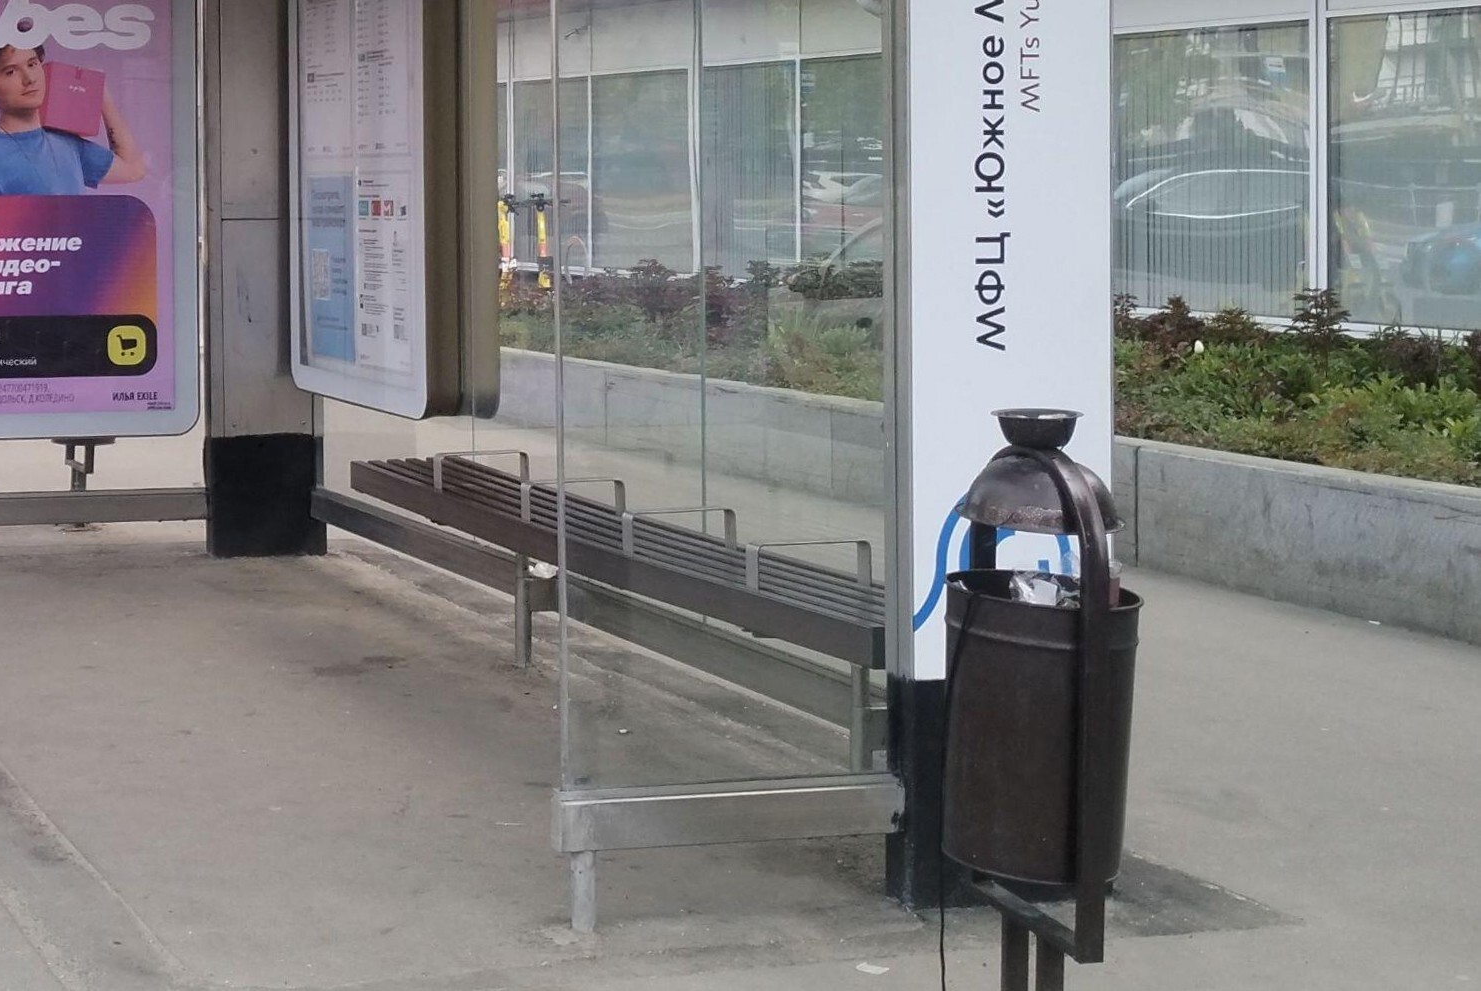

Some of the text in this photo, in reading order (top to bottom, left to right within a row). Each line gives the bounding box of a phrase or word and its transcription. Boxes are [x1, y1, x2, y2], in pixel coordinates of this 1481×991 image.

[1018, 36, 1042, 113] MFTs
[974, 35, 1008, 220] «Южное
[974, 231, 1012, 352] МФЦ
[112, 391, 158, 401] ИЛЬЯ EXILE
